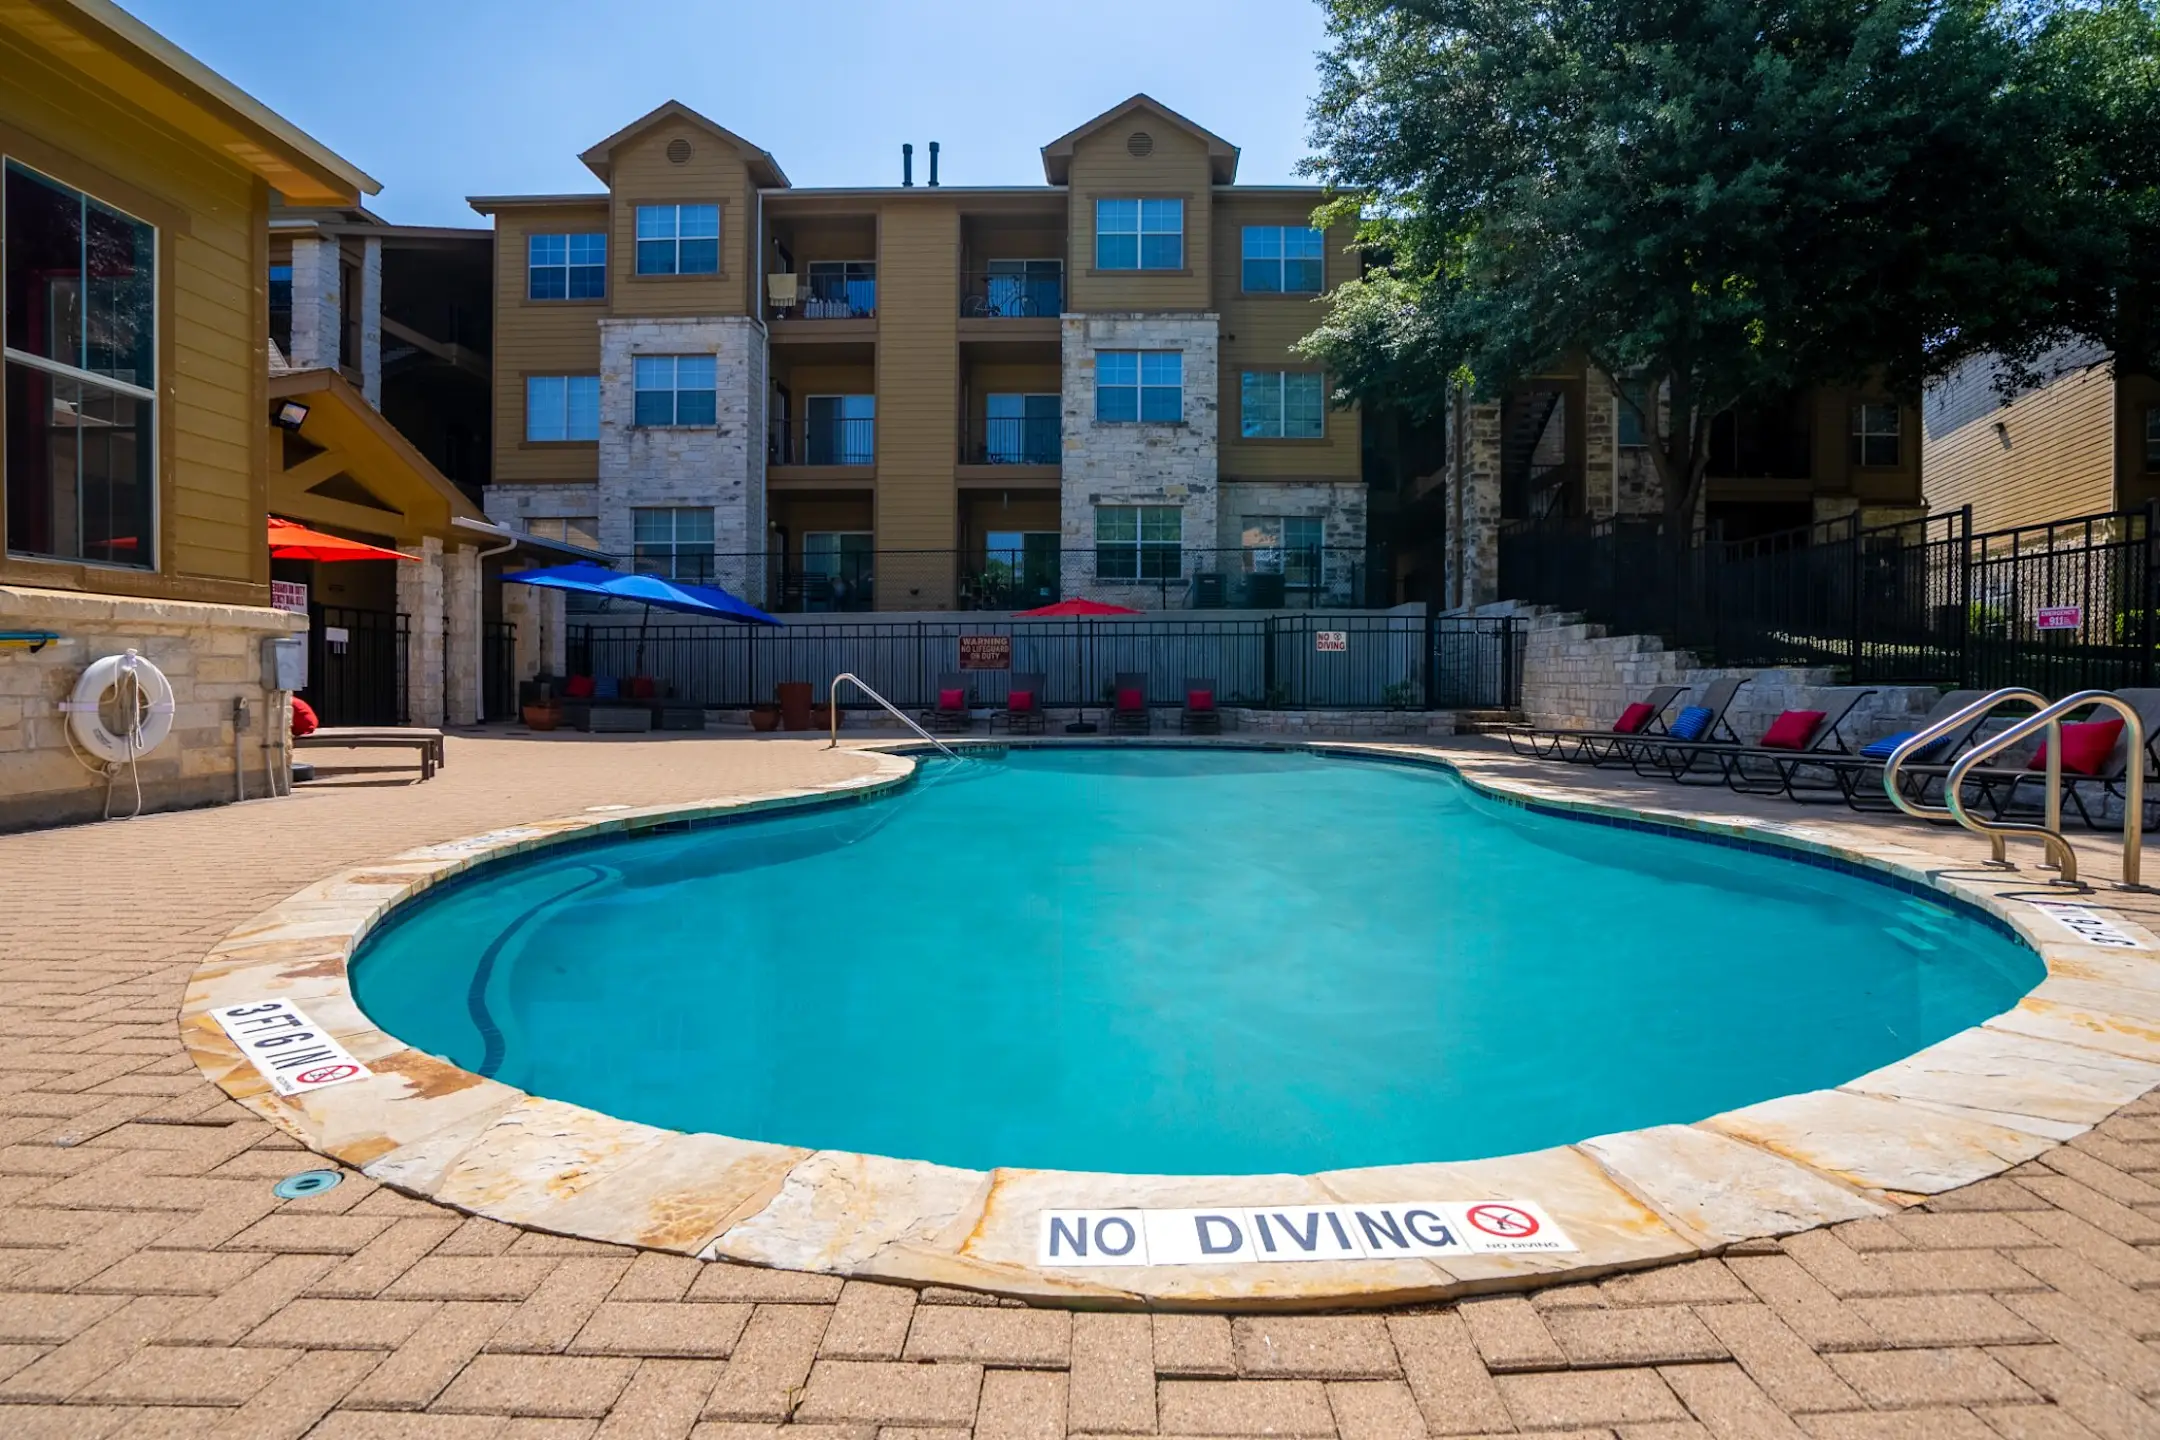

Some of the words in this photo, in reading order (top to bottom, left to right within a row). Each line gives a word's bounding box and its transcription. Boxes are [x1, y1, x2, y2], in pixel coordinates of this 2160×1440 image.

[2049, 616, 2063, 625] 911
[1317, 642, 1345, 650] DIVING
[1048, 1216, 1136, 1257] NO
[1194, 1209, 1459, 1255] DIVING
[1511, 1241, 1560, 1249] DIVING
